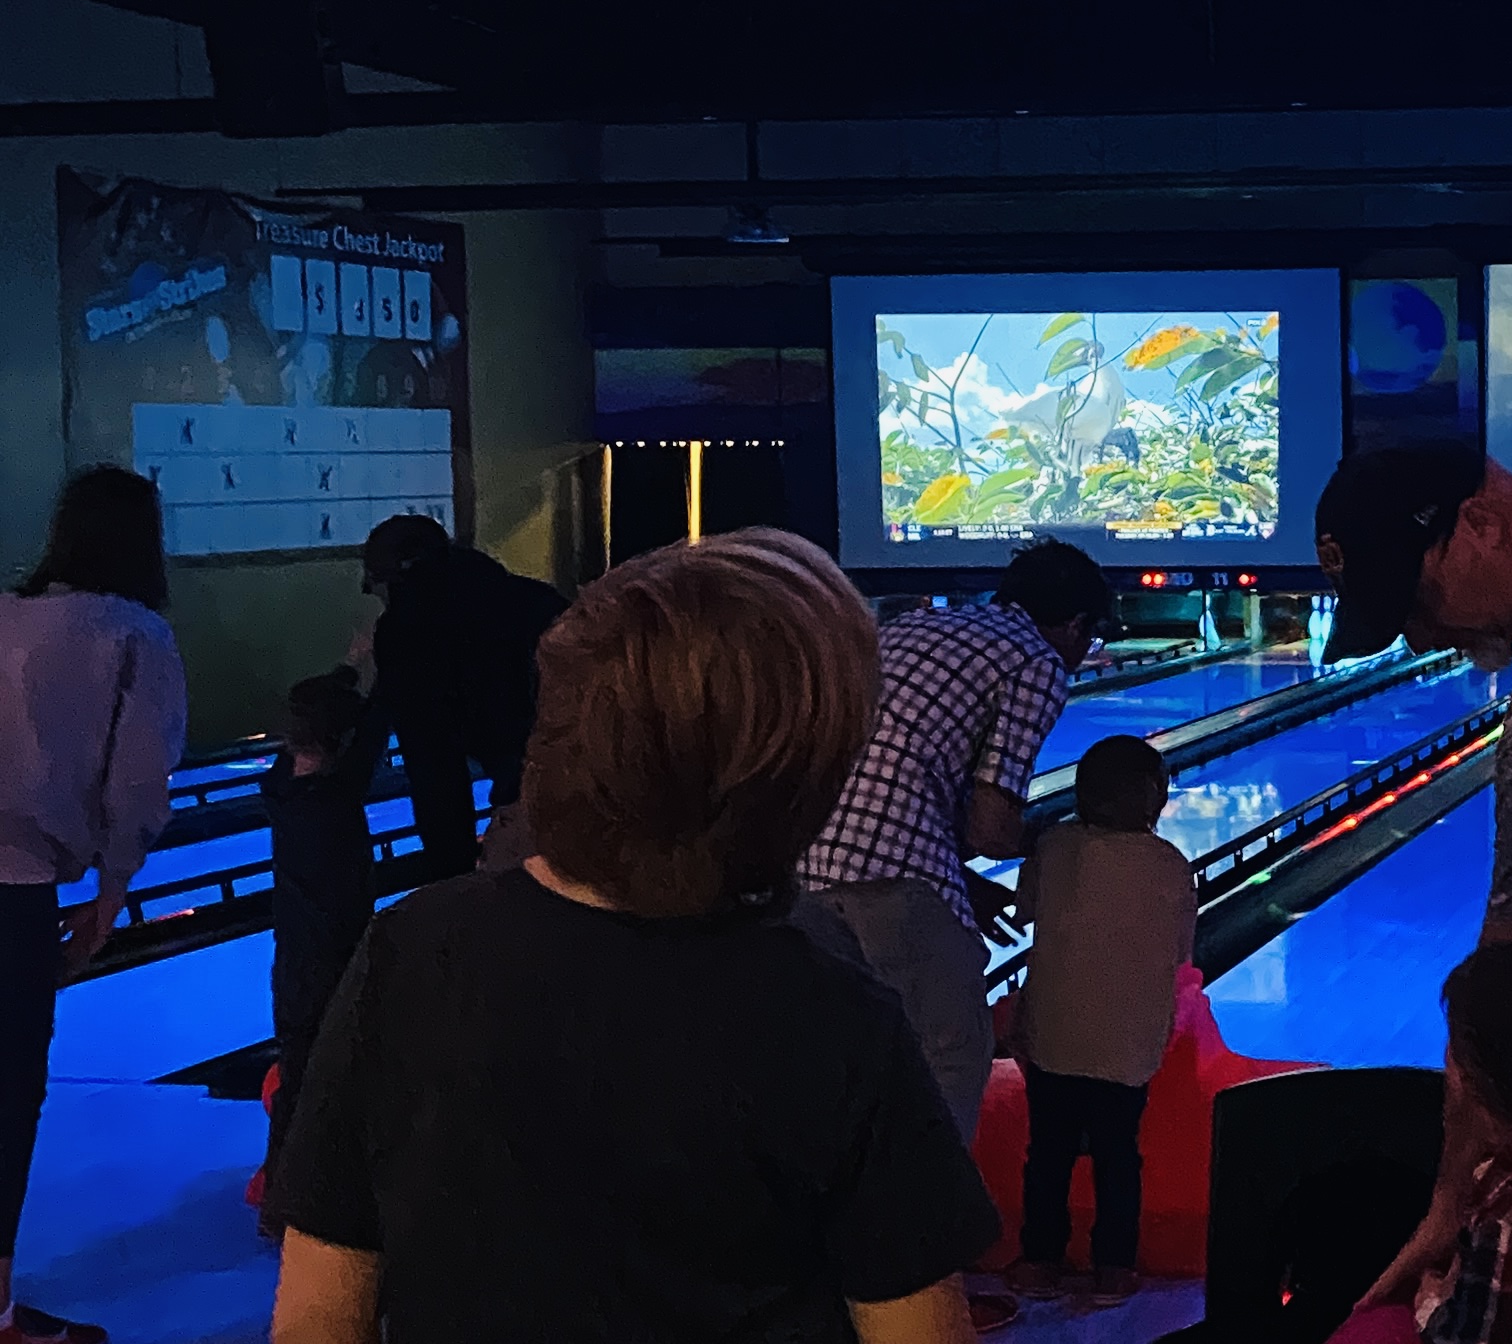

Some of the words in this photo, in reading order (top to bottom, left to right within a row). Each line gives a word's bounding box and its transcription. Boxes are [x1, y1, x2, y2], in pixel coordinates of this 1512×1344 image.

[255, 219, 329, 249] Treasure
[332, 223, 381, 256] Chest
[384, 230, 446, 264] Jackpot
[1211, 571, 1229, 586] 11
